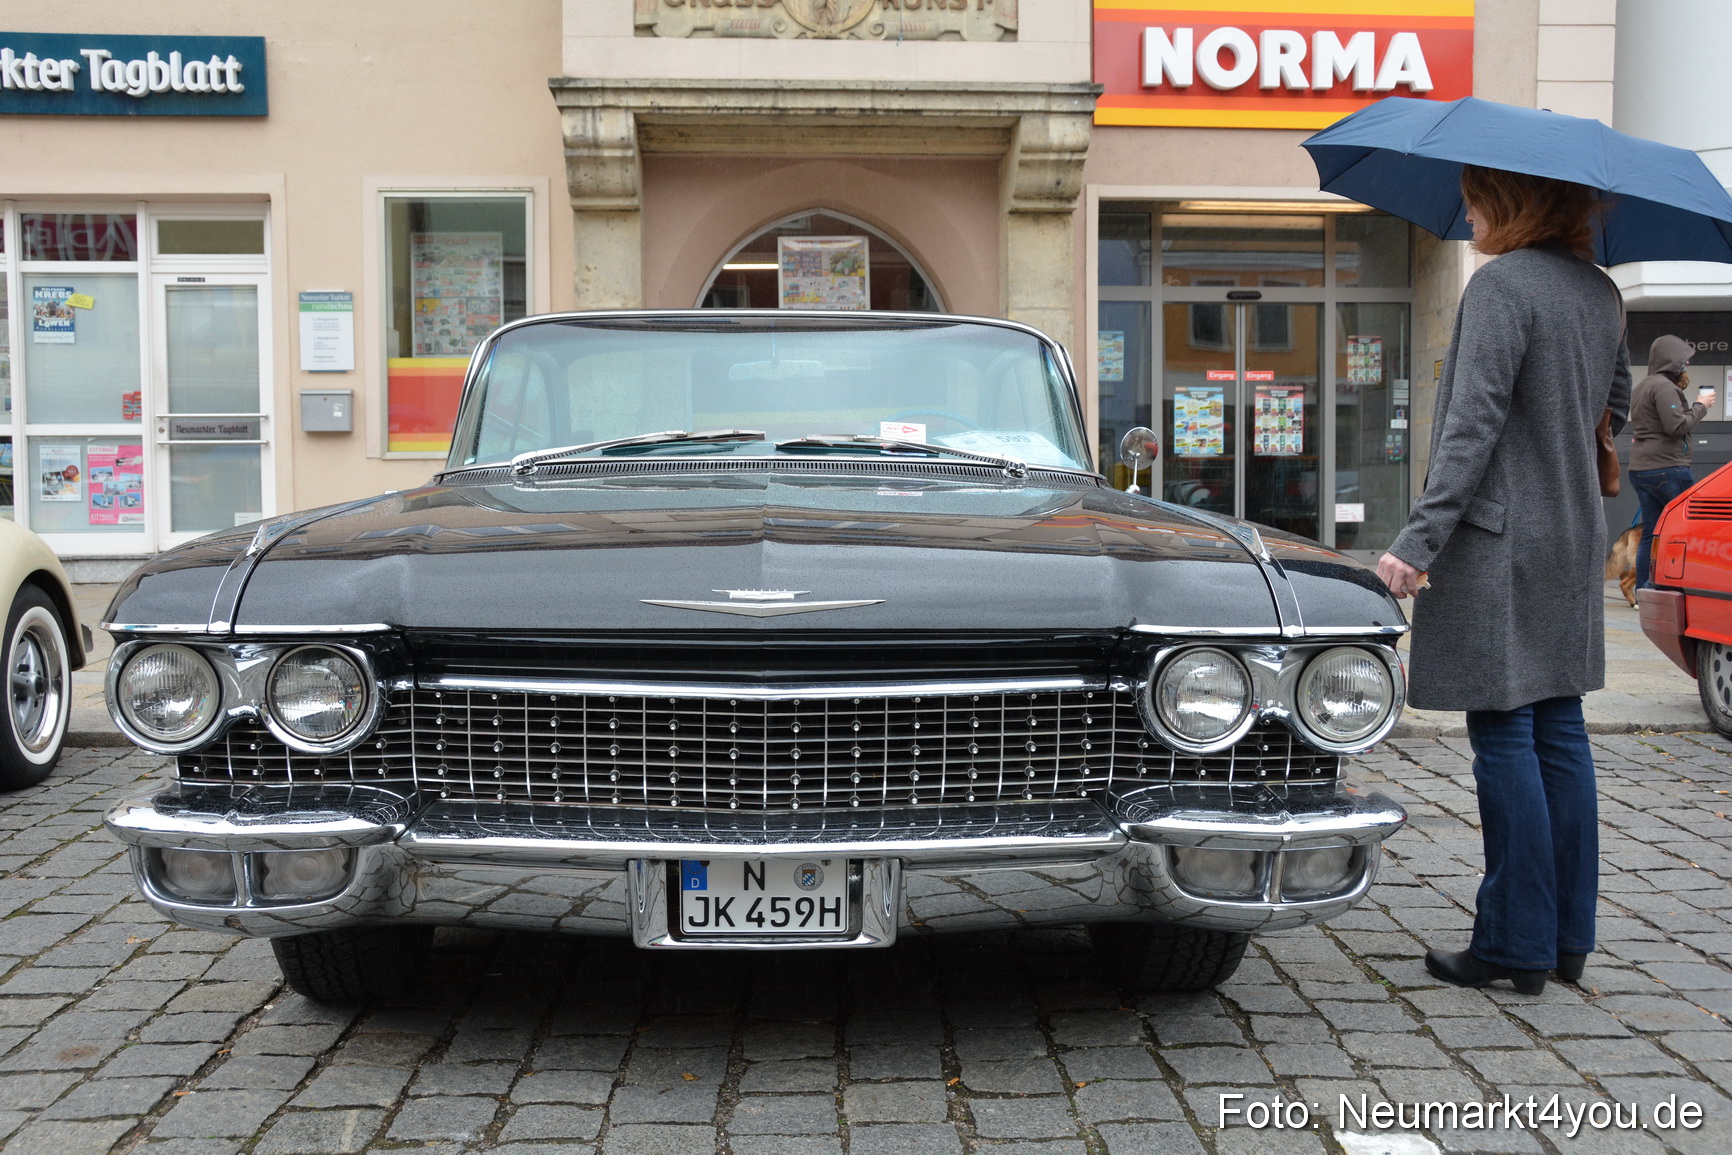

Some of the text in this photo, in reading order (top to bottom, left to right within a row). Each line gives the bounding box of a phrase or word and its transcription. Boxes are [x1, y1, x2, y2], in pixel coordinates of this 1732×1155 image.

[1142, 26, 1434, 93] NORMA
[0, 47, 245, 99] kter Tagblatt
[1208, 371, 1235, 380] Eingang
[1246, 372, 1272, 380] Eingang
[176, 425, 248, 434] Neumarkter Tagblatt
[691, 877, 701, 889] D
[743, 861, 766, 891] N
[688, 896, 841, 928] JK 459H
